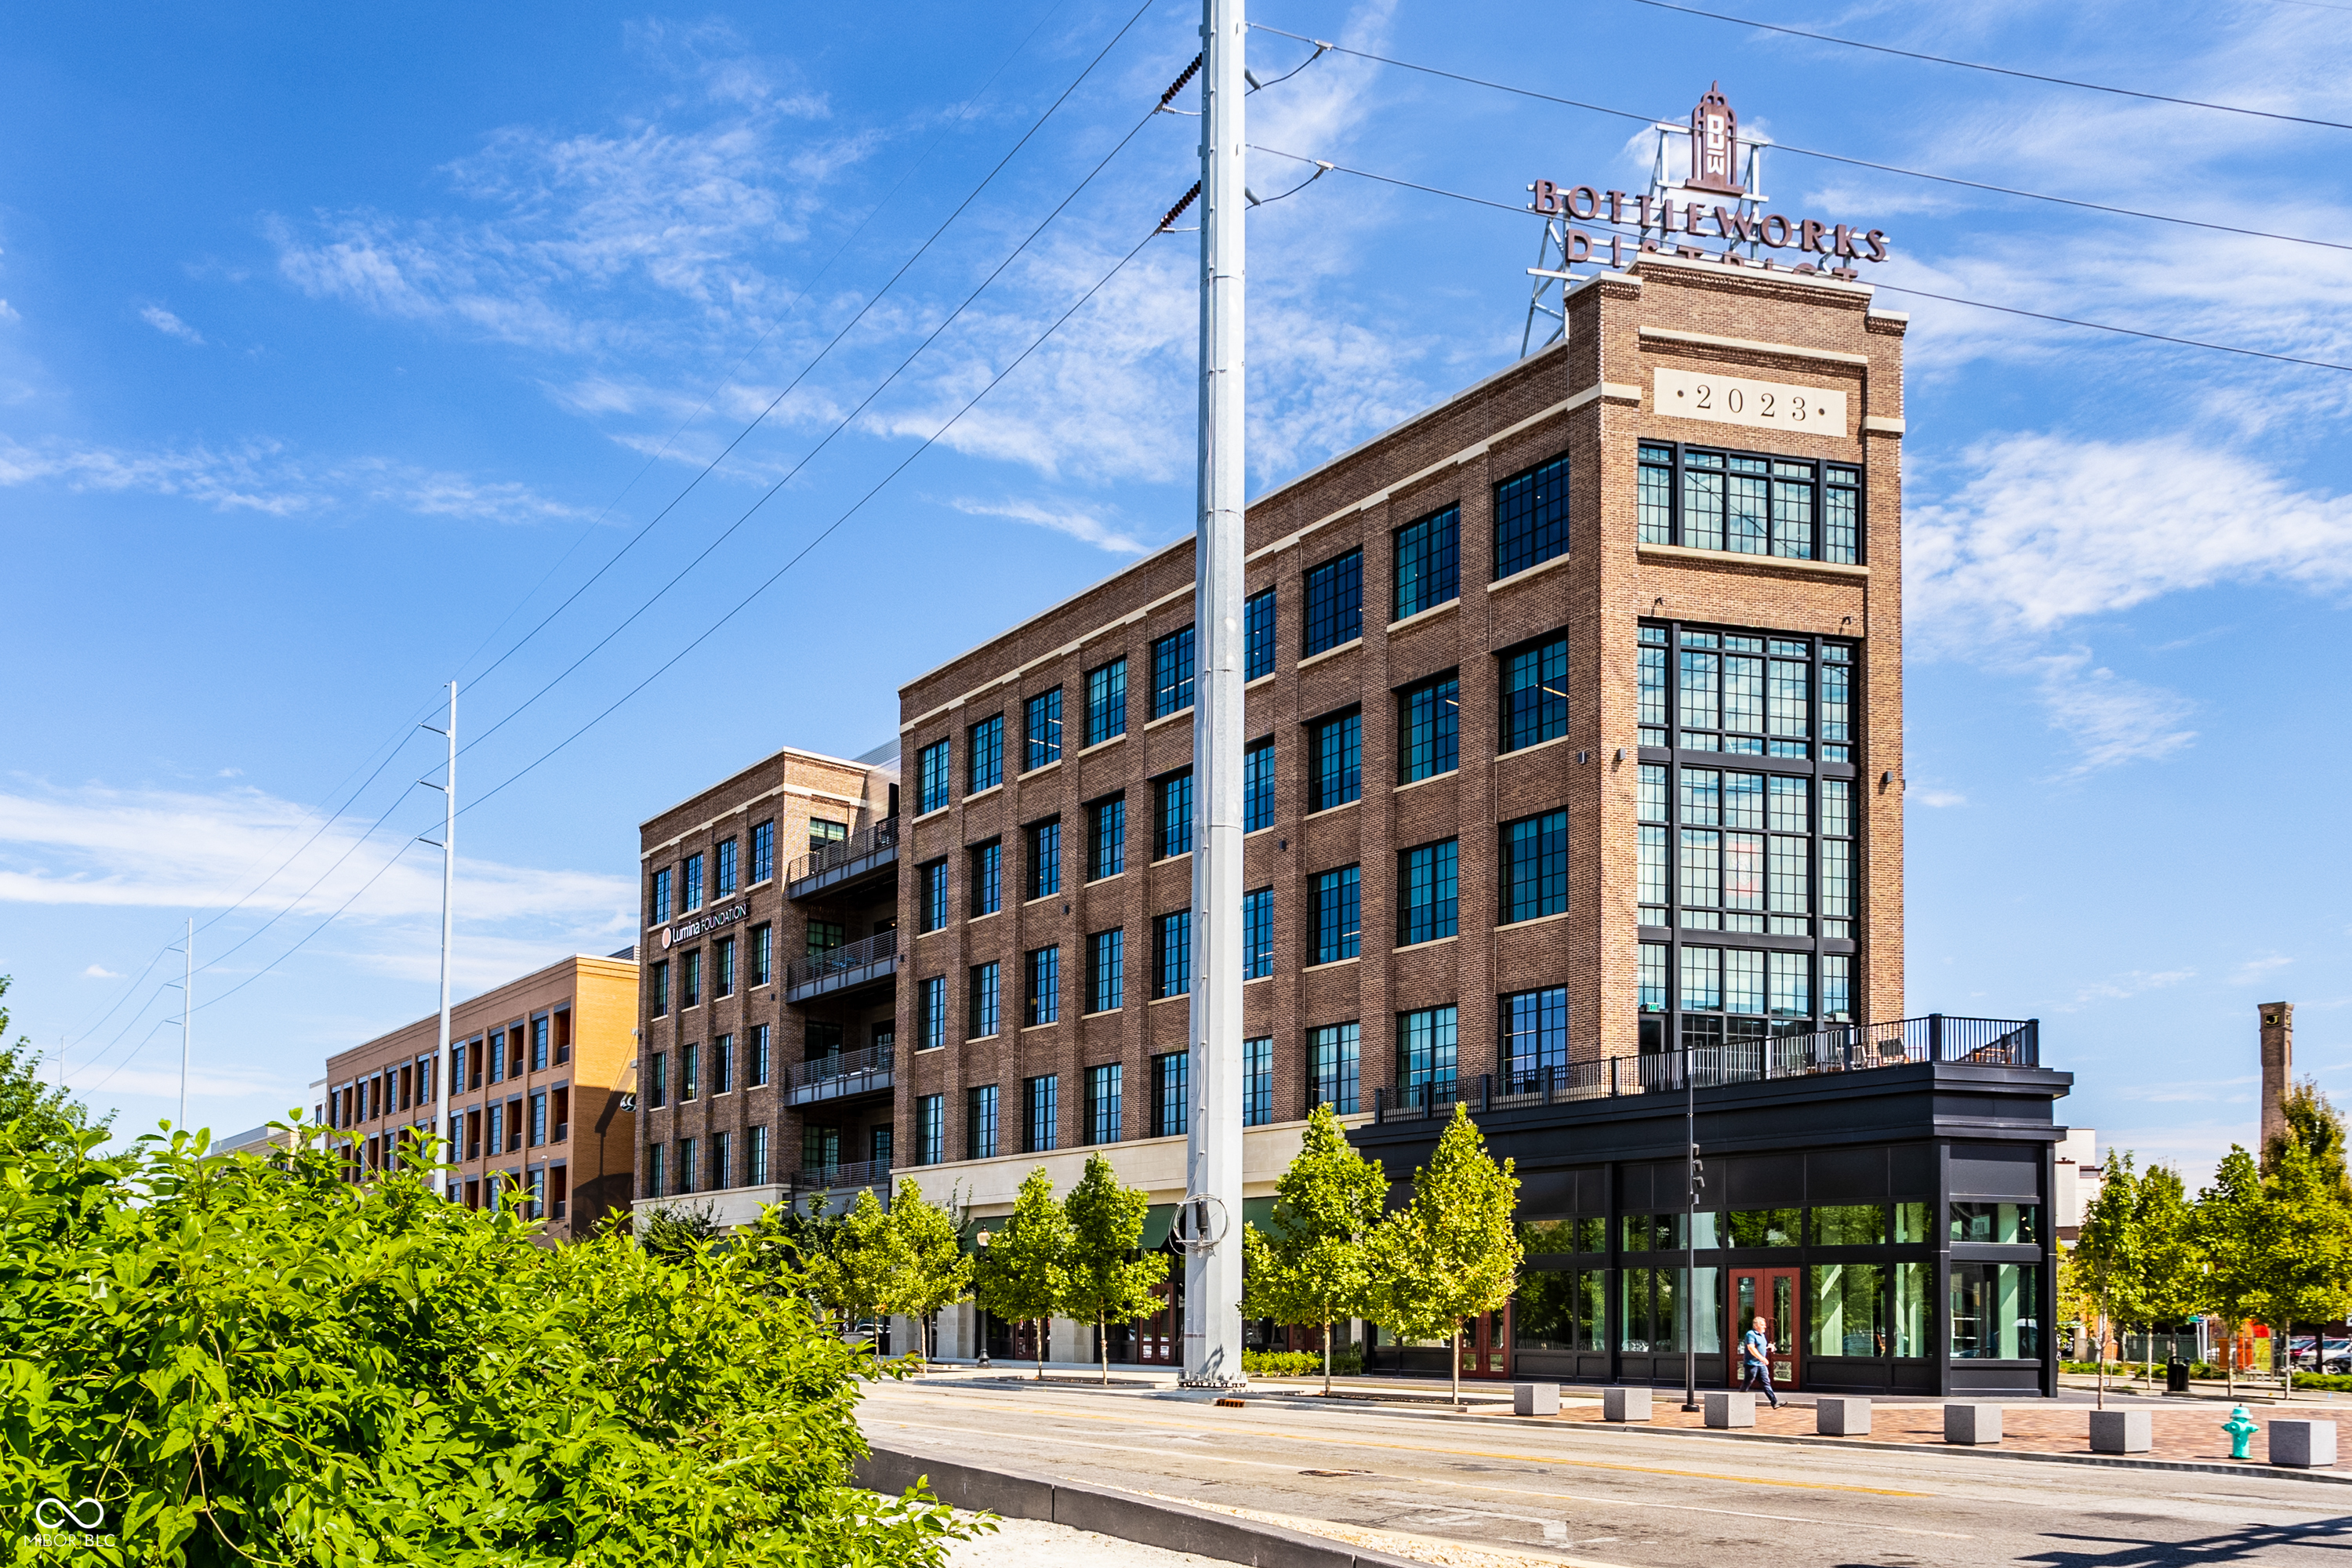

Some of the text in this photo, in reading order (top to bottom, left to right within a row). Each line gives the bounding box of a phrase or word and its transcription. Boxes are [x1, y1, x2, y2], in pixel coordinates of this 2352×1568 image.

[1535, 179, 1886, 263] BOTTLEWORKS
[1697, 384, 1806, 421] 2023
[672, 903, 746, 943] Lumina FOUNDATION
